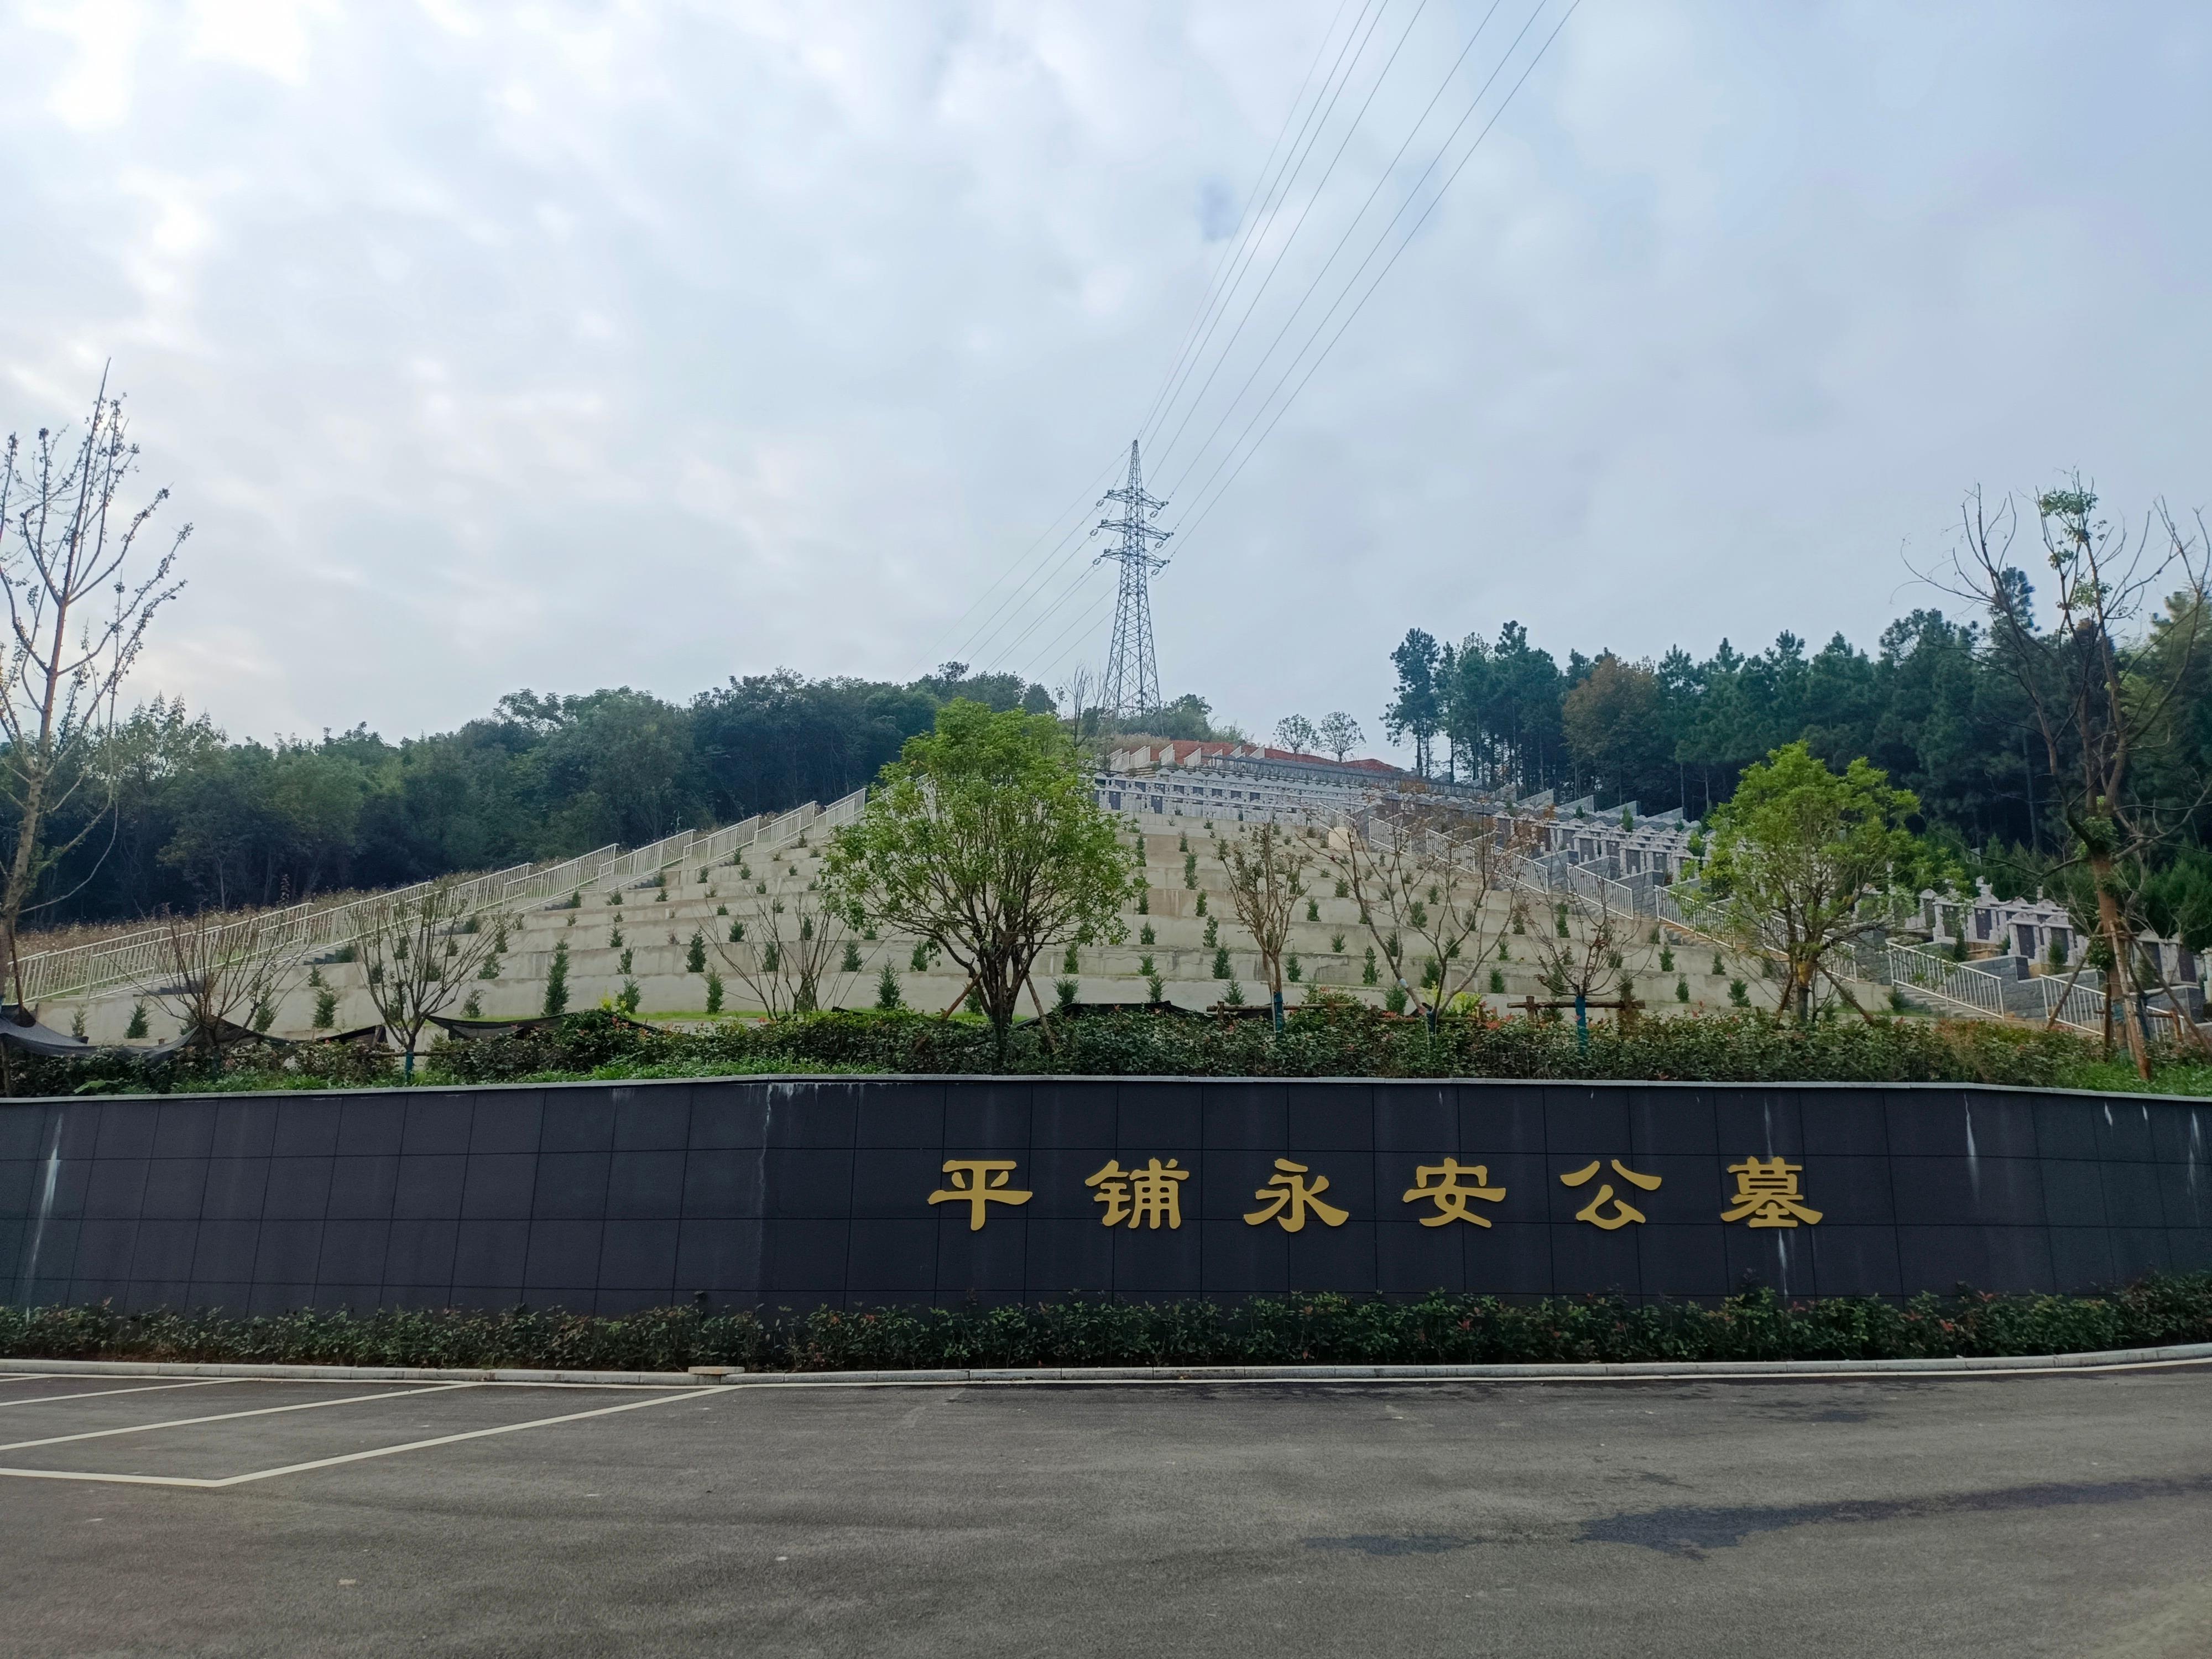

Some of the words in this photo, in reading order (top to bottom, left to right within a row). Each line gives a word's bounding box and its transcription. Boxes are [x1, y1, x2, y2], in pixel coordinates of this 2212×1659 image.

[927, 1156, 1823, 1232] 平铺永安公墓
